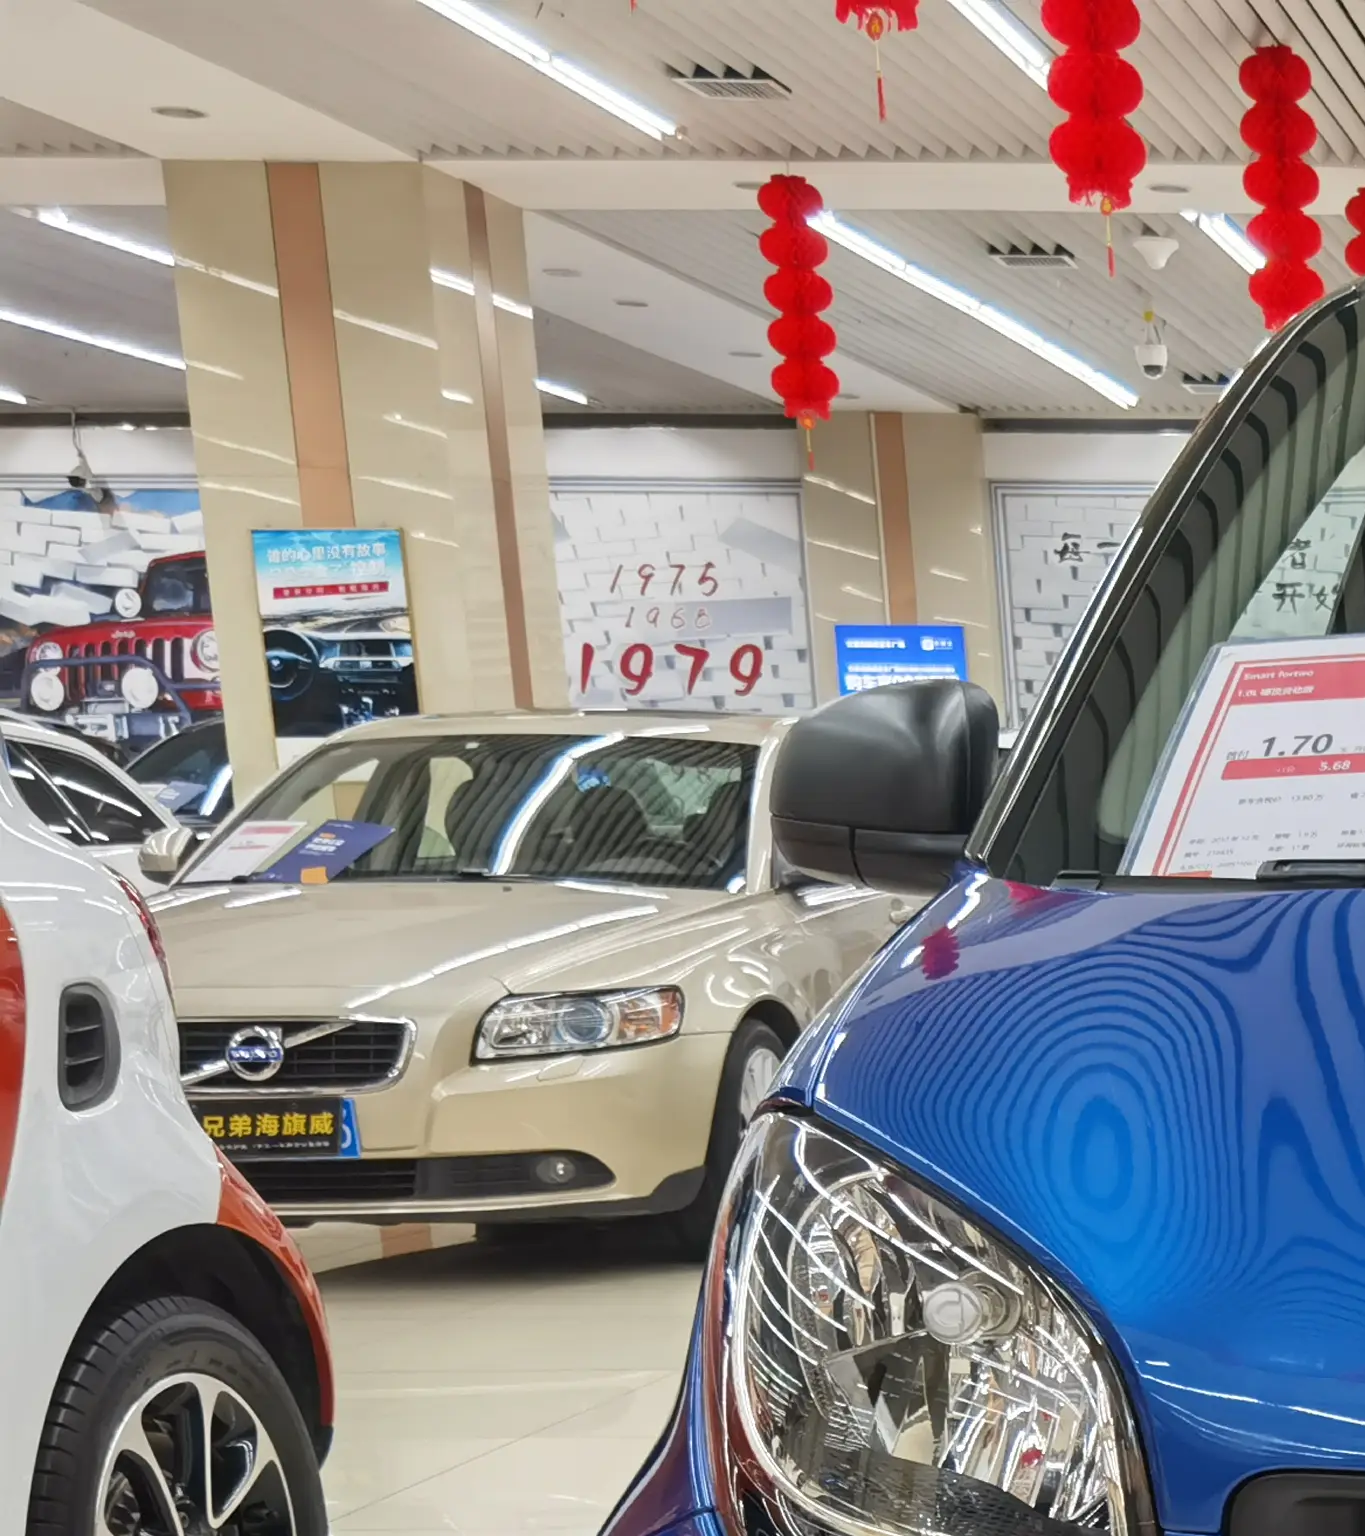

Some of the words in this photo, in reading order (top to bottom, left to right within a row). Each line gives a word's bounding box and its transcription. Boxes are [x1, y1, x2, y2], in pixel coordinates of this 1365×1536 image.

[609, 562, 718, 596] 1975
[625, 606, 711, 629] 1968
[580, 643, 763, 696] 1979
[1262, 734, 1334, 758] 1.70
[1319, 761, 1352, 772] 5.68
[203, 1112, 335, 1138] 兄弟海旗威
